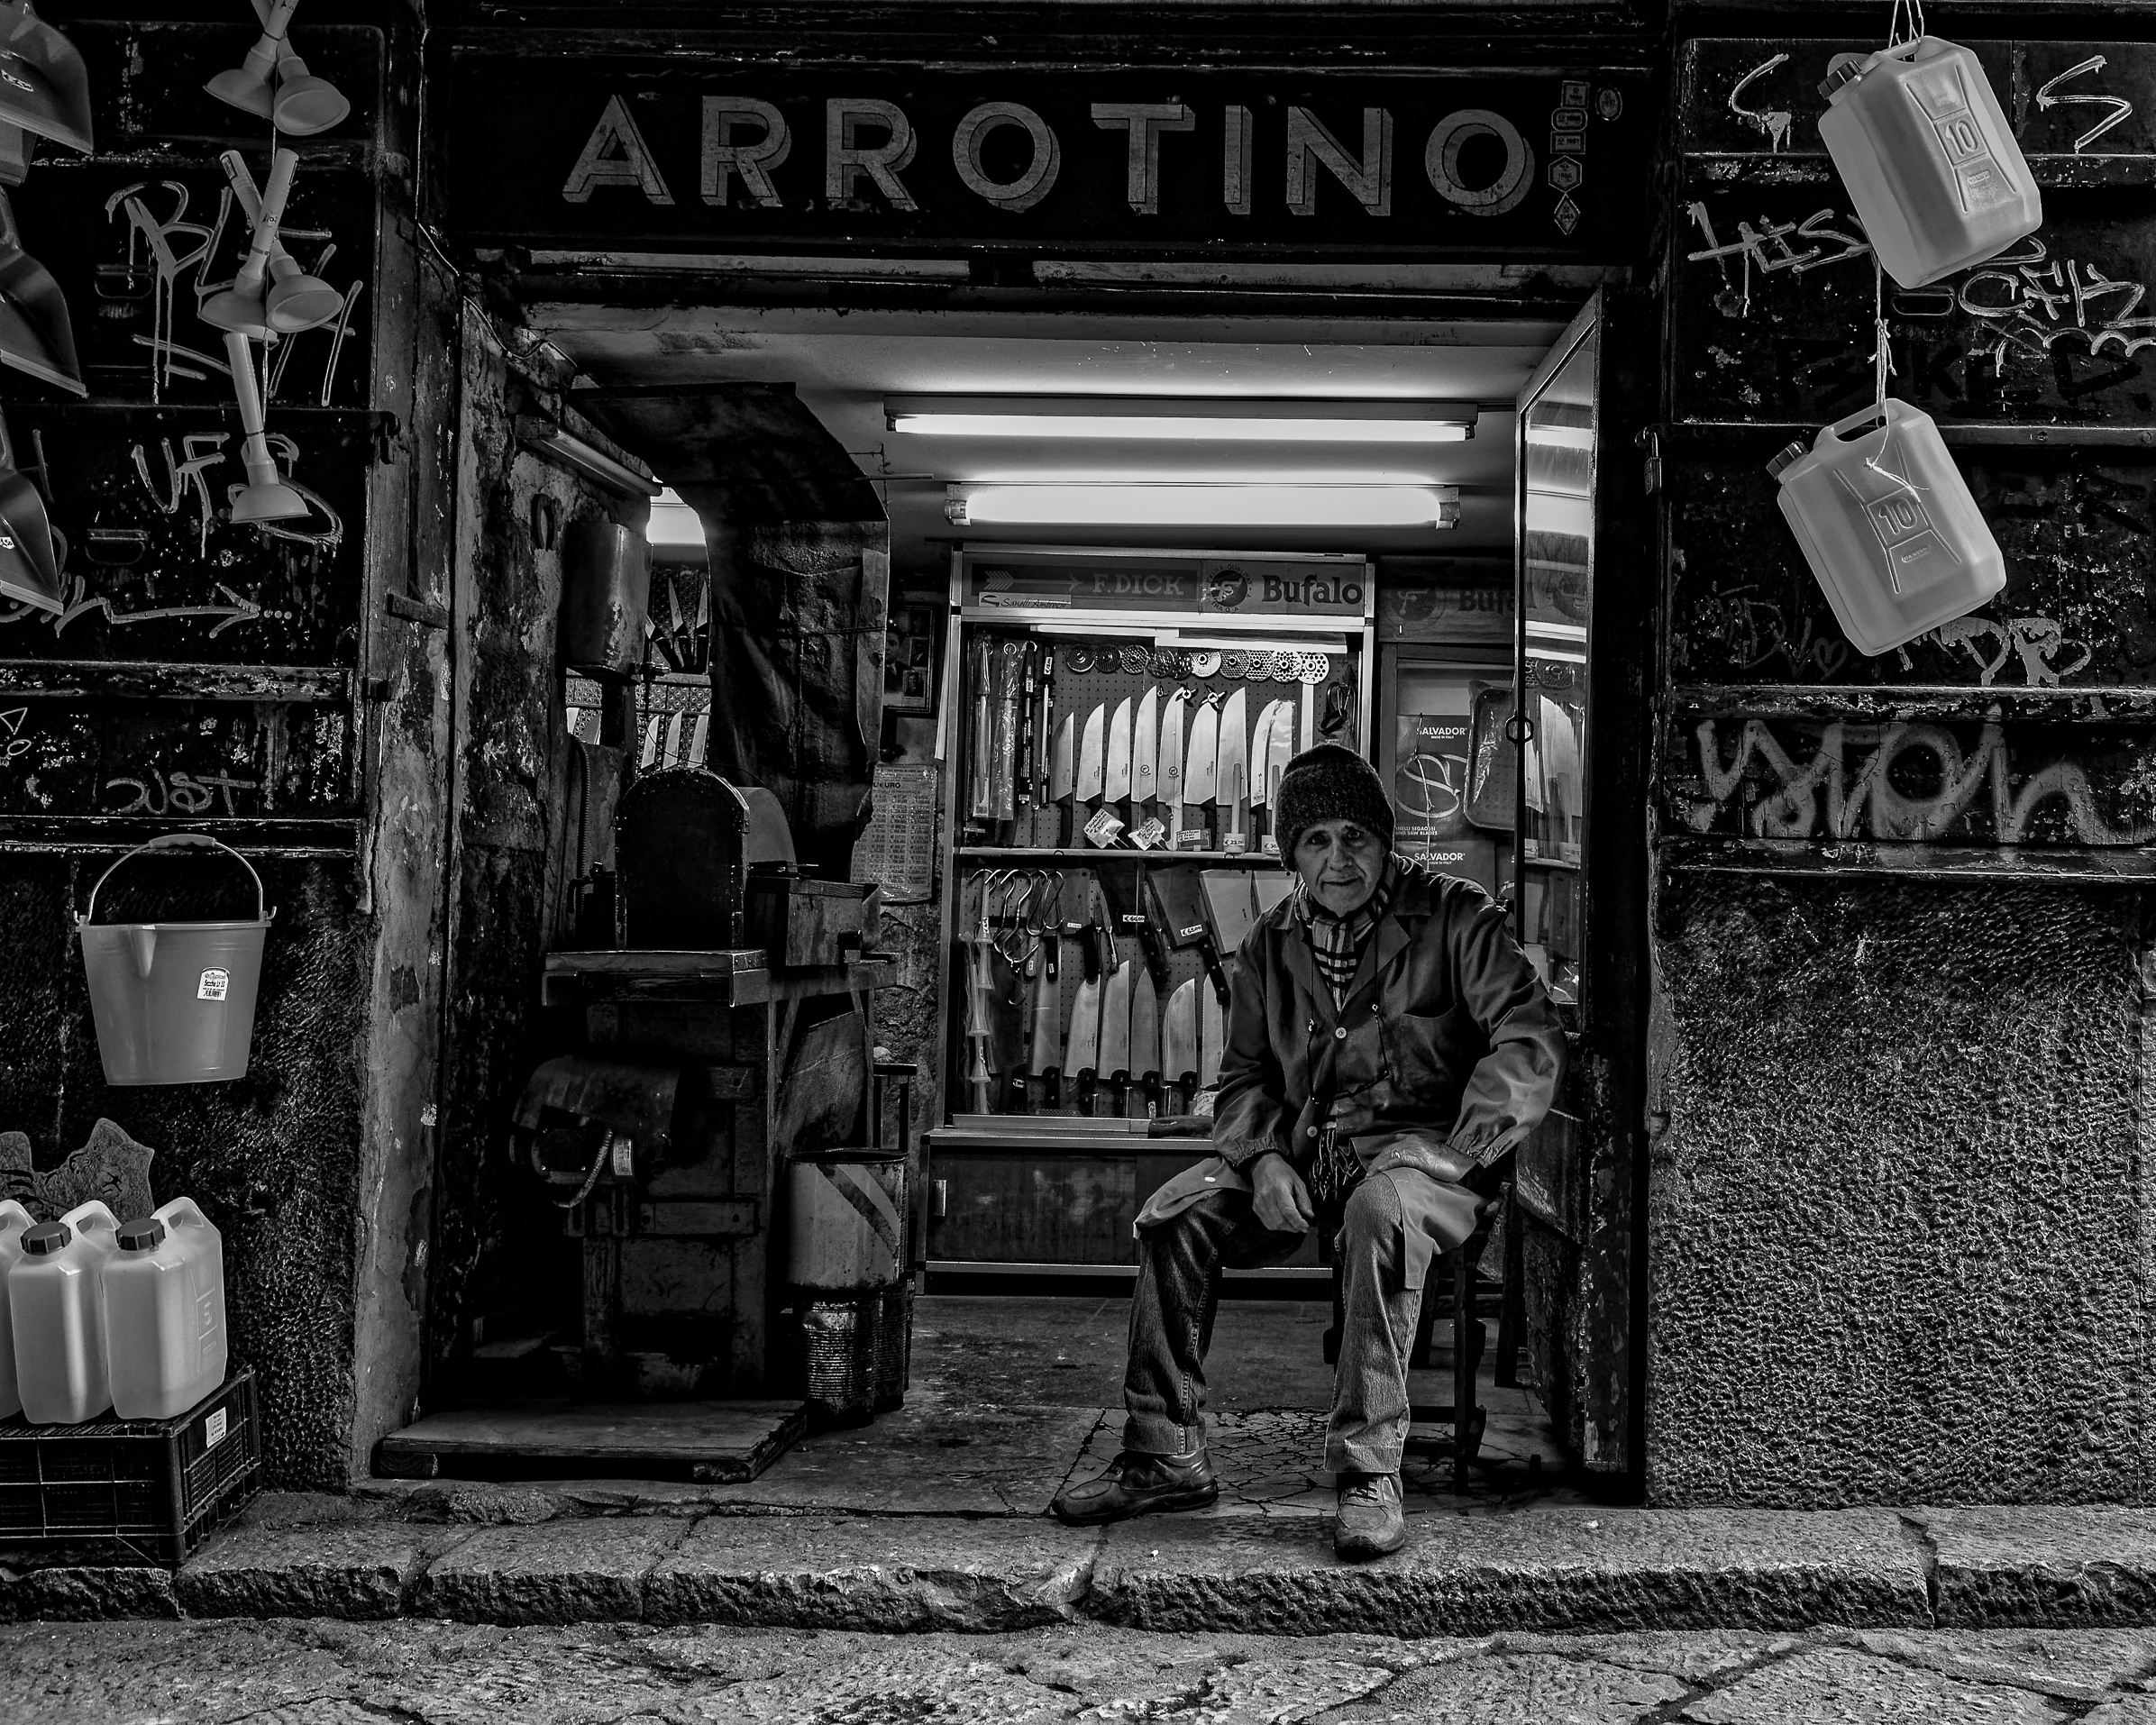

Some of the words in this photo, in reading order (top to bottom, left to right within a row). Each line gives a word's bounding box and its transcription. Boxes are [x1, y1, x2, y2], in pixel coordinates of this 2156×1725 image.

[562, 93, 1534, 217] ARROTINO
[1945, 120, 1978, 156] 10
[1878, 497, 1917, 535] 10
[1092, 573, 1184, 595] F.DICK
[1261, 573, 1363, 607] Bufalo
